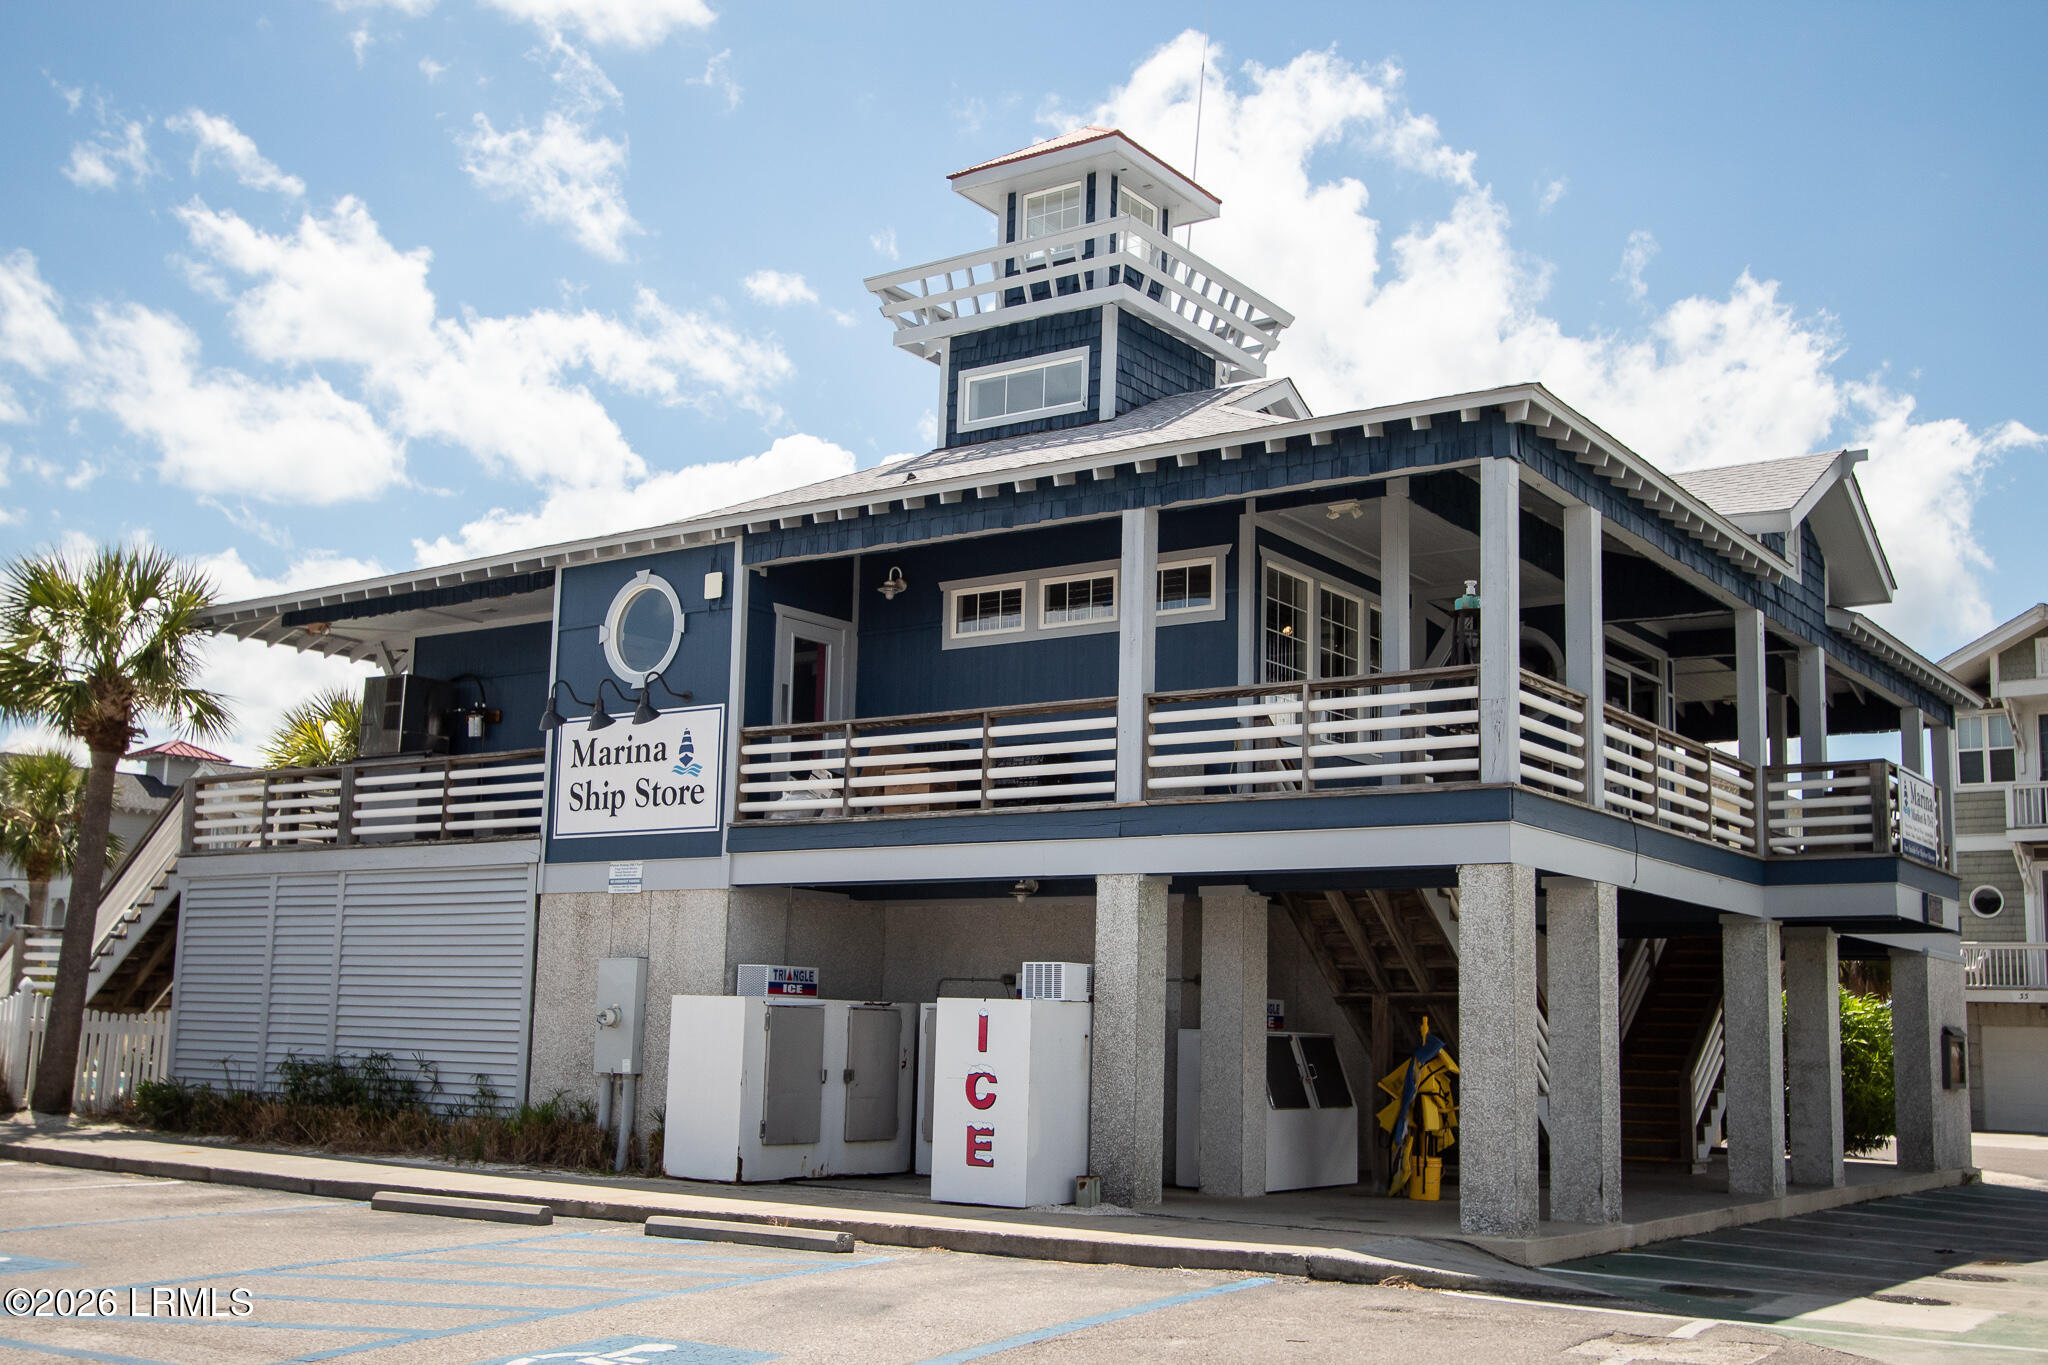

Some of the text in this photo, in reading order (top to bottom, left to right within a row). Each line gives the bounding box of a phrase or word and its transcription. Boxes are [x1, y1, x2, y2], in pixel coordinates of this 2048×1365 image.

[570, 734, 668, 768] Marina
[569, 778, 705, 817] Ship Store
[1910, 781, 1934, 813] Marina
[773, 968, 815, 982] TRIANGLE
[782, 983, 803, 993] ICE
[965, 1008, 998, 1168] ICE
